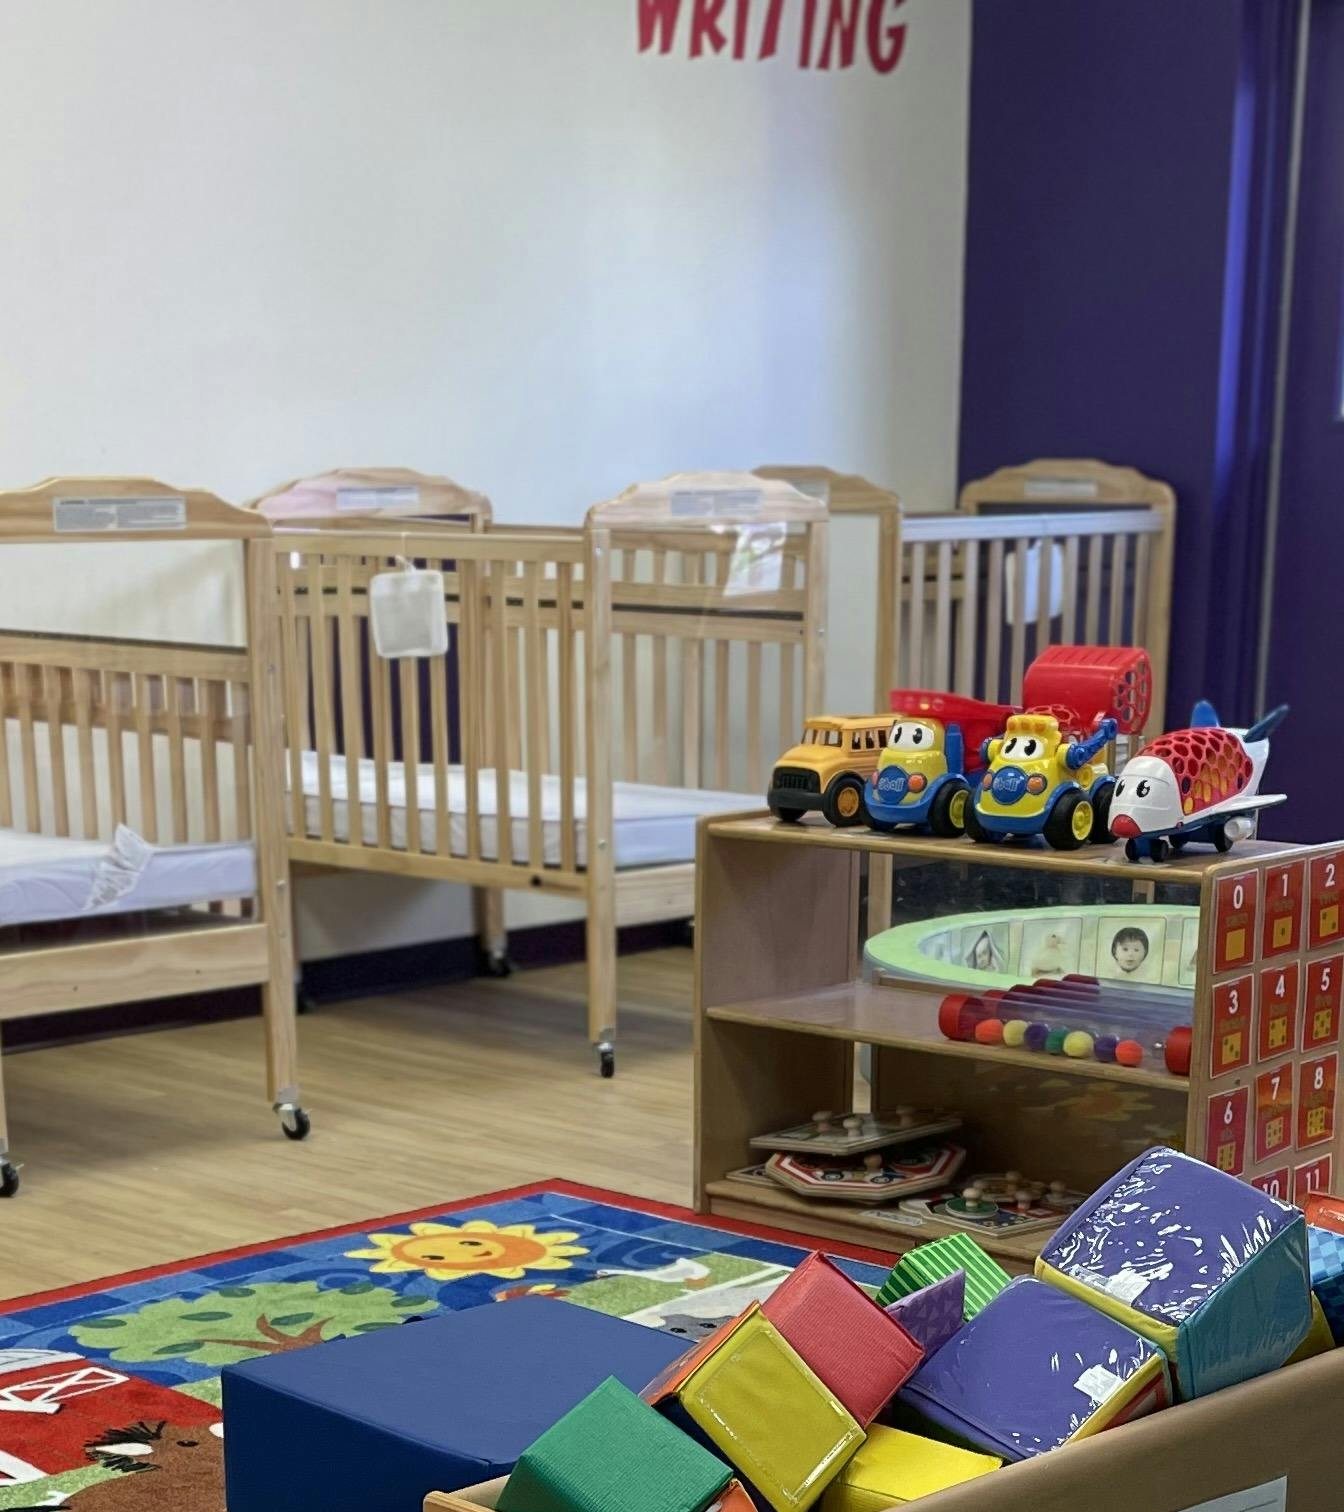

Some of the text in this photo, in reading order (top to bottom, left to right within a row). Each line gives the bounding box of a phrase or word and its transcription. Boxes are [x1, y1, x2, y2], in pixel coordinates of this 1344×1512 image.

[636, 0, 908, 74] WRITING
[1282, 874, 1289, 897] 1
[1325, 863, 1335, 888] 2
[1233, 885, 1244, 909] 0
[1275, 975, 1286, 998] 4
[1321, 967, 1330, 991] 5
[1228, 990, 1239, 1014] 3
[1271, 1076, 1280, 1101] 7
[1314, 1066, 1324, 1090] 8
[1223, 1101, 1233, 1124] 6
[1305, 1168, 1320, 1193] 11
